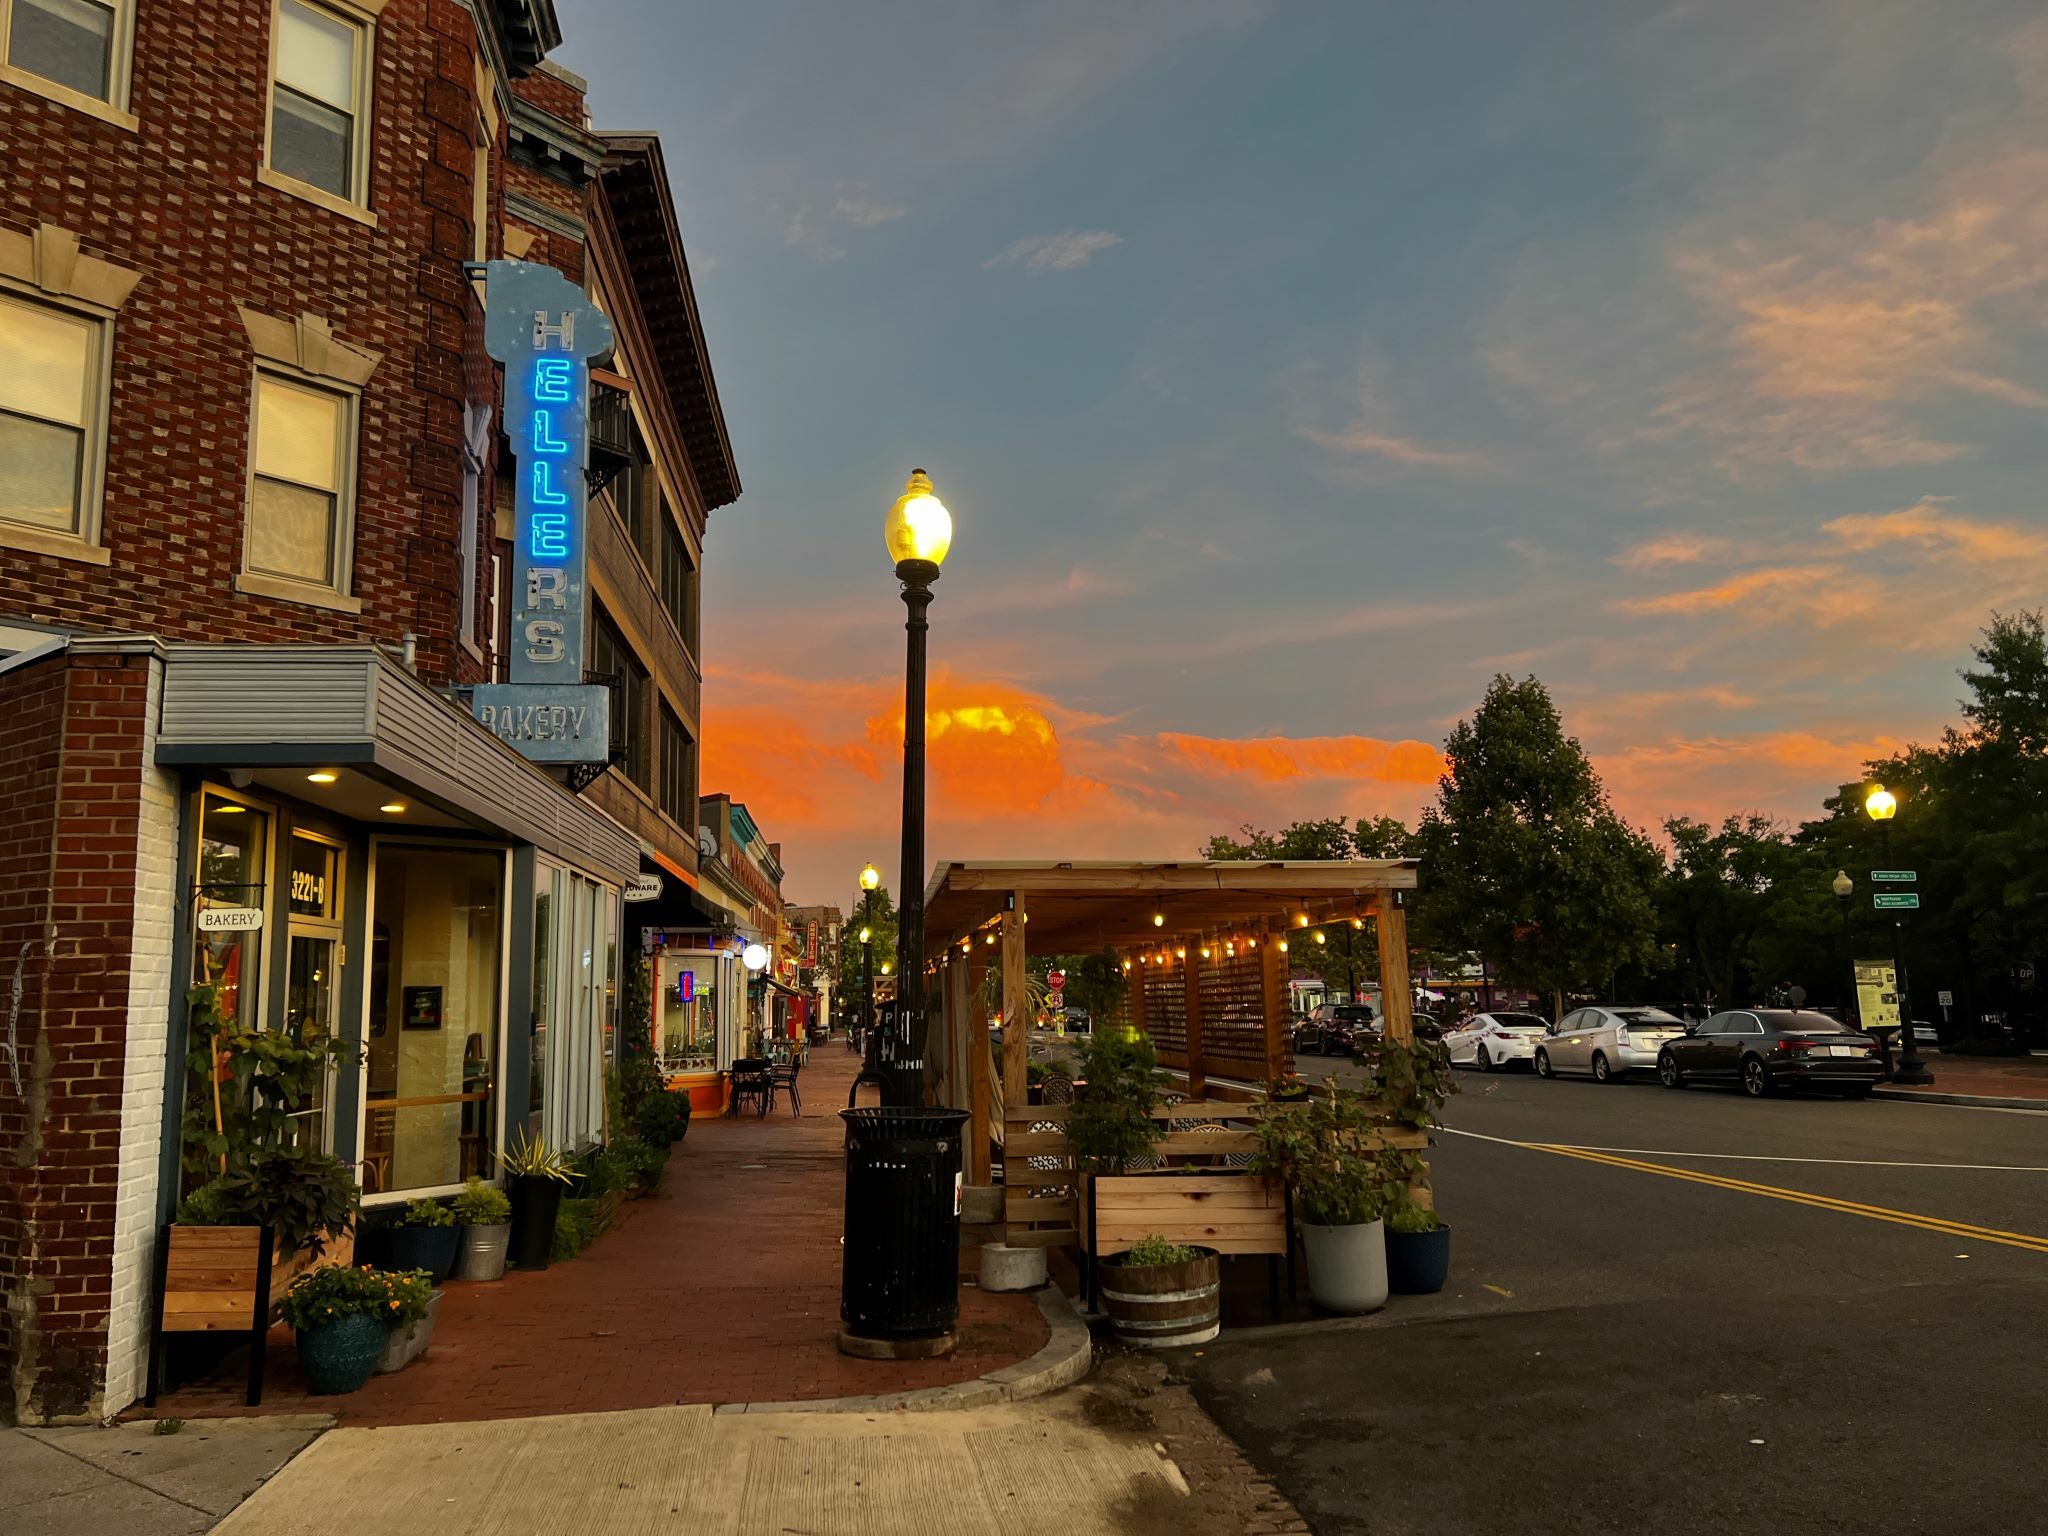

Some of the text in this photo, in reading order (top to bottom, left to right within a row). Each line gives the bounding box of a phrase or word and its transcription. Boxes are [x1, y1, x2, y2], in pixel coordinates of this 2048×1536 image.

[525, 310, 575, 664] HELLERS
[481, 705, 586, 740] BAKERY
[291, 870, 325, 905] 3221-B
[205, 913, 257, 926] BAKERY
